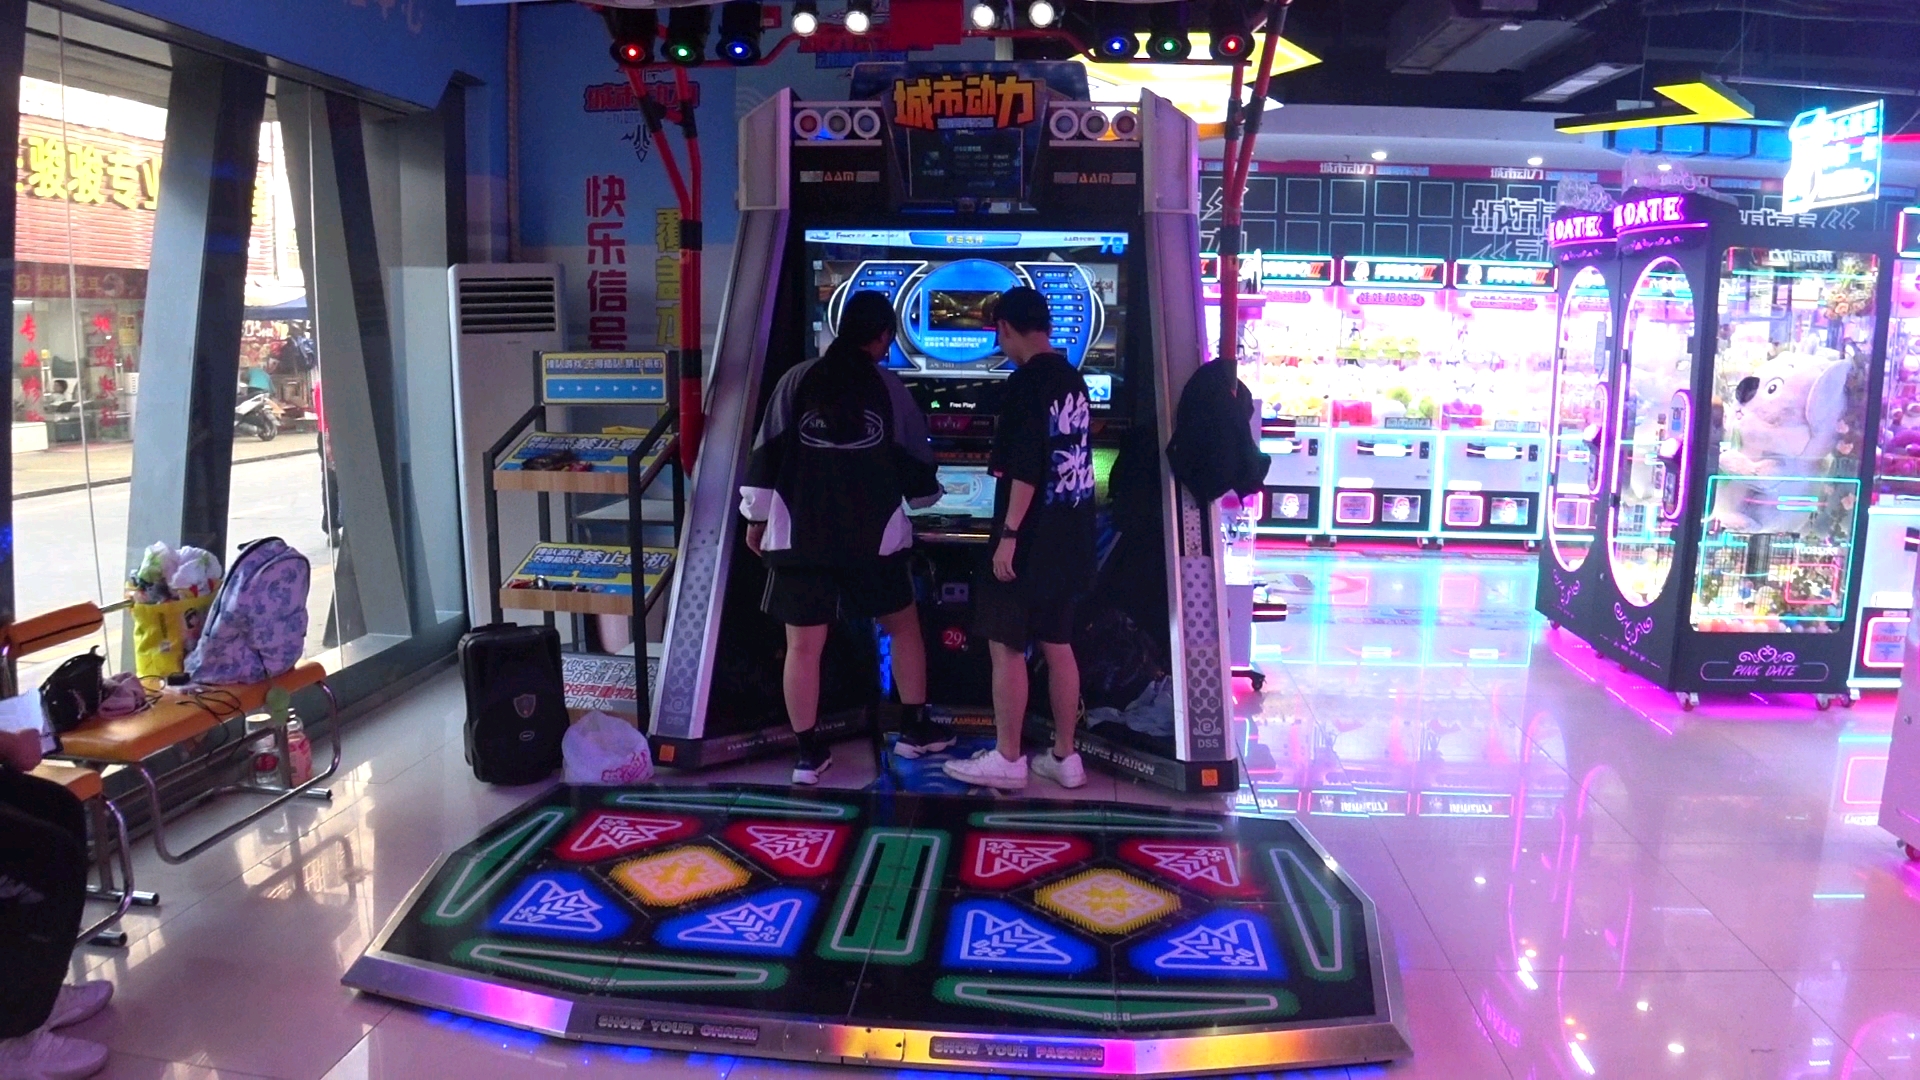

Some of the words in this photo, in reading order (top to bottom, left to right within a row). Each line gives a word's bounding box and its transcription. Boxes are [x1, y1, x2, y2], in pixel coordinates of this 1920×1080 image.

[893, 74, 1035, 131] 城市动力
[586, 175, 628, 350] 快乐信号
[944, 630, 963, 646] 29
[1732, 665, 1763, 677] PINK
[1765, 664, 1798, 677] DATE
[1197, 738, 1219, 748] DSS
[1081, 741, 1110, 760] SUPER
[1111, 753, 1155, 775] STATION
[598, 1015, 645, 1031] SHOW
[651, 1020, 694, 1035] YOUR
[700, 1024, 759, 1041] CHARM
[933, 1040, 980, 1055] SHOW
[985, 1044, 1029, 1058] YOUR
[1035, 1046, 1103, 1061] PASSION
